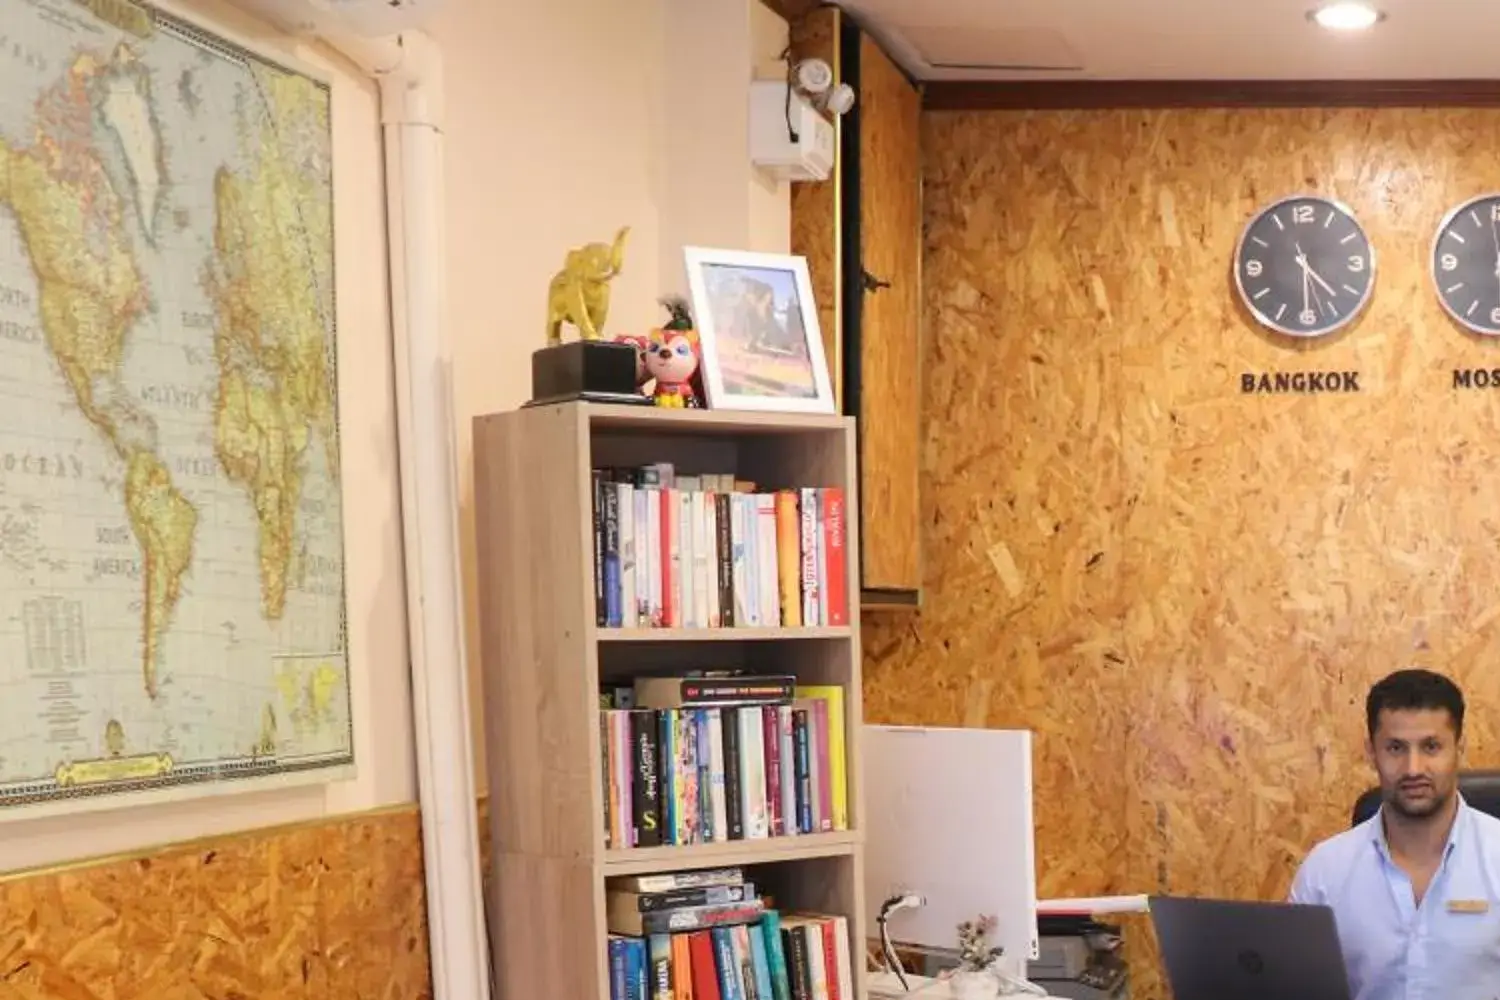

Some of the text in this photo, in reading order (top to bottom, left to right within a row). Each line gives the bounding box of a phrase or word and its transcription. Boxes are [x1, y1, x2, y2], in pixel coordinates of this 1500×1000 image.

[1292, 205, 1315, 224] 12
[1246, 258, 1263, 277] 9
[1348, 255, 1364, 273] 3
[1440, 253, 1457, 272] 9
[1241, 371, 1360, 394] BANGKOK
